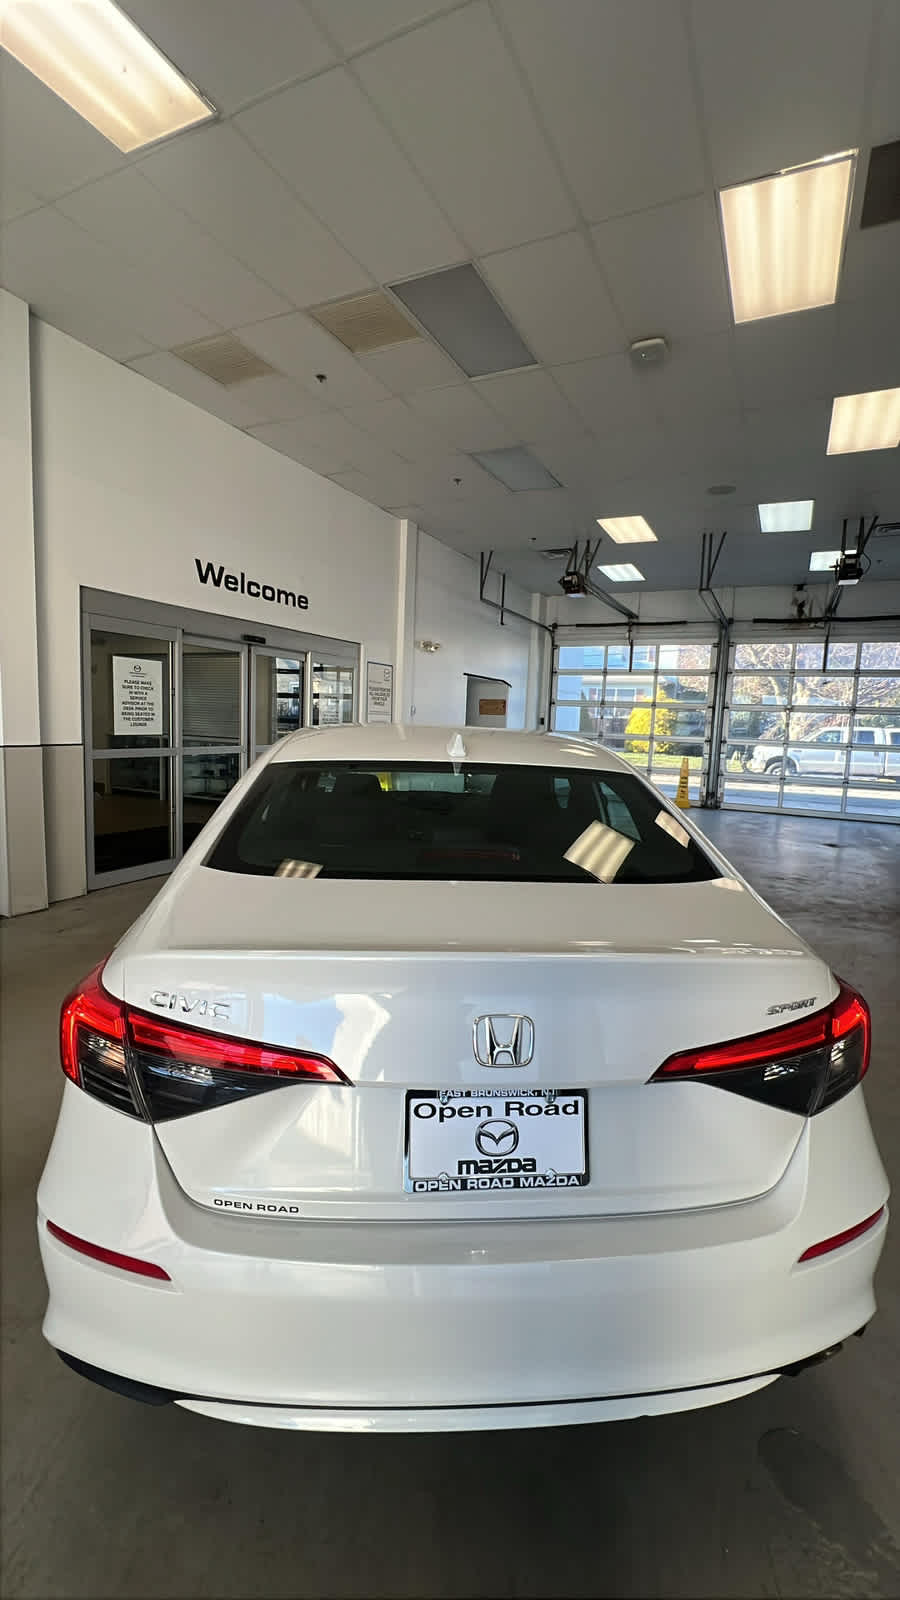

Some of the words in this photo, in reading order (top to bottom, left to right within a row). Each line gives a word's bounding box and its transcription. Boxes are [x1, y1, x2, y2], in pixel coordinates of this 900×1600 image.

[194, 558, 309, 610] Welcome
[150, 990, 231, 1020] CIVIC
[766, 996, 817, 1016] SPORT
[439, 1088, 468, 1098] EAST
[413, 1102, 493, 1123] Open
[504, 1100, 580, 1117] Road
[415, 1181, 462, 1193] OPEN
[467, 1178, 514, 1190] ROAD
[519, 1175, 580, 1188] MAZDA
[213, 1198, 253, 1210] OPEN
[256, 1203, 299, 1214] ROAD
